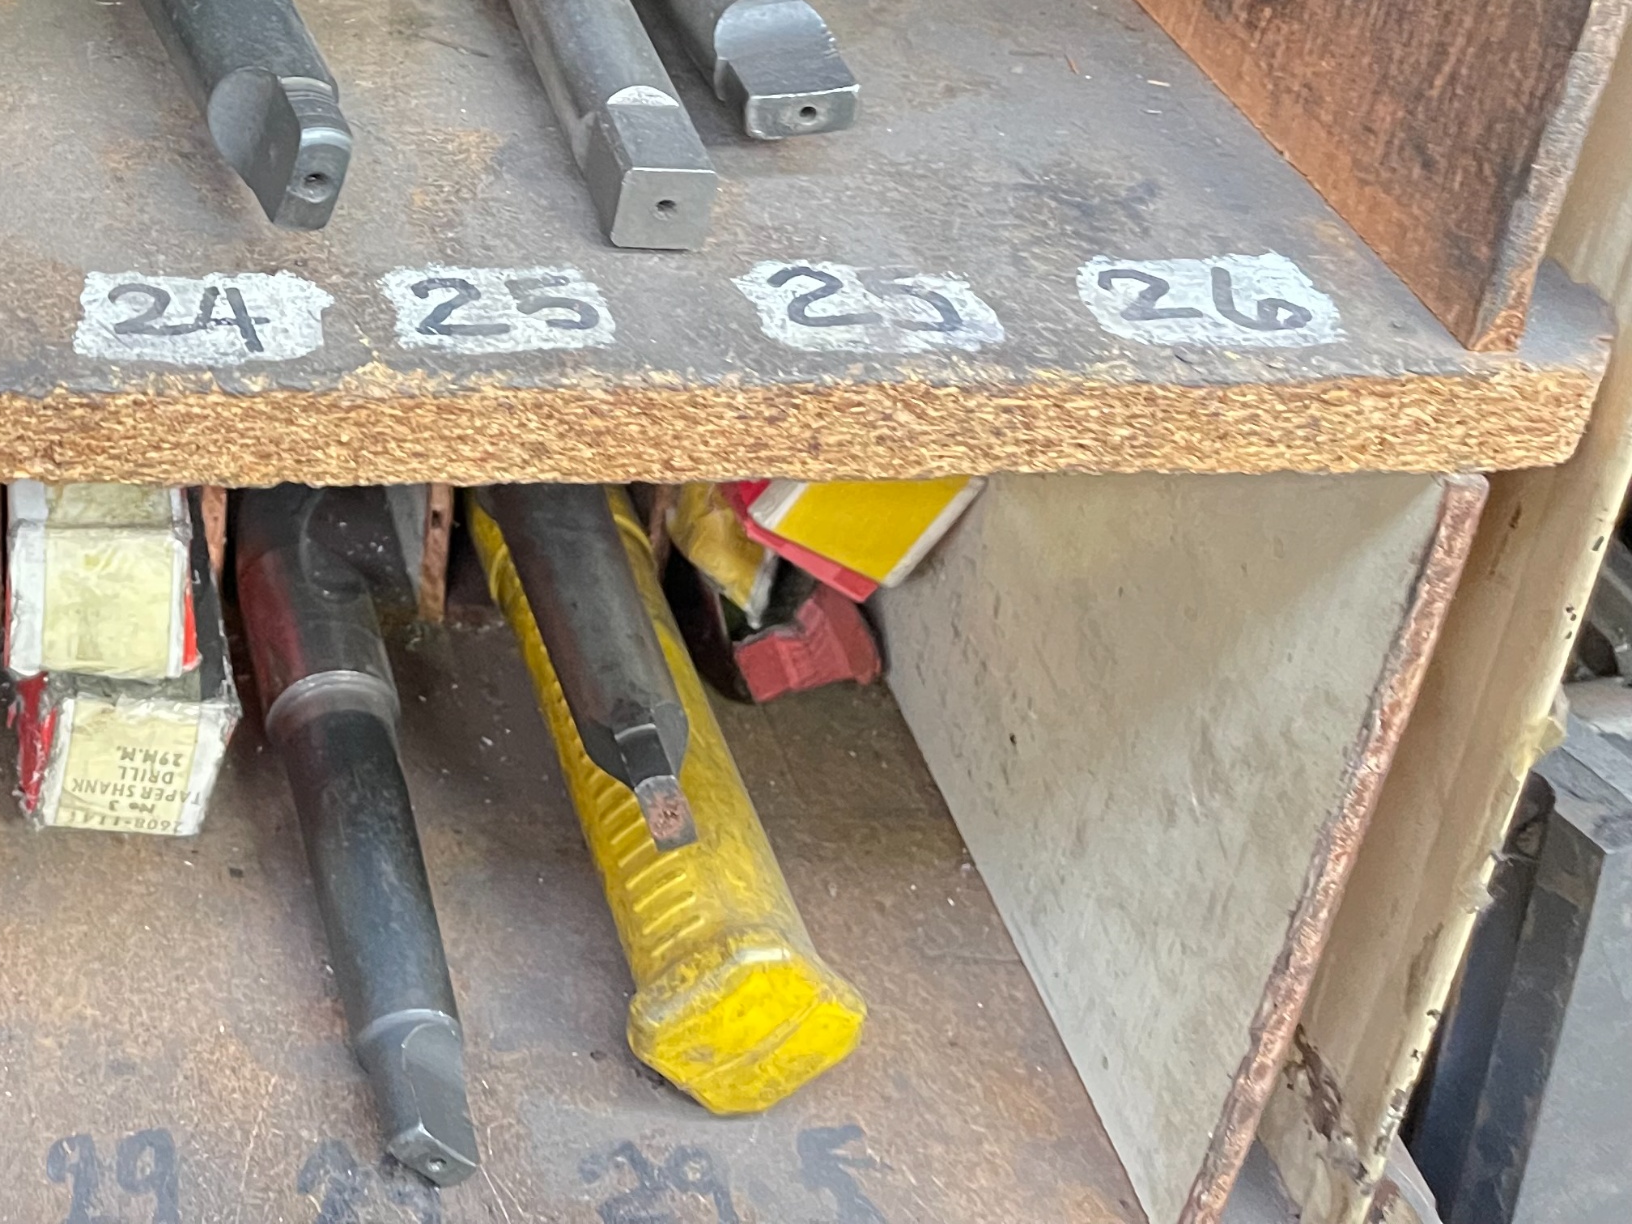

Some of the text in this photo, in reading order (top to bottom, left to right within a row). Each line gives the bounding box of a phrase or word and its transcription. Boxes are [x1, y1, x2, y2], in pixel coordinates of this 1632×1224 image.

[106, 282, 273, 354] 24
[409, 276, 601, 337] 25
[1097, 265, 1313, 332] 26
[71, 777, 201, 805] TAPER SHANK
[118, 765, 175, 785] DRILL
